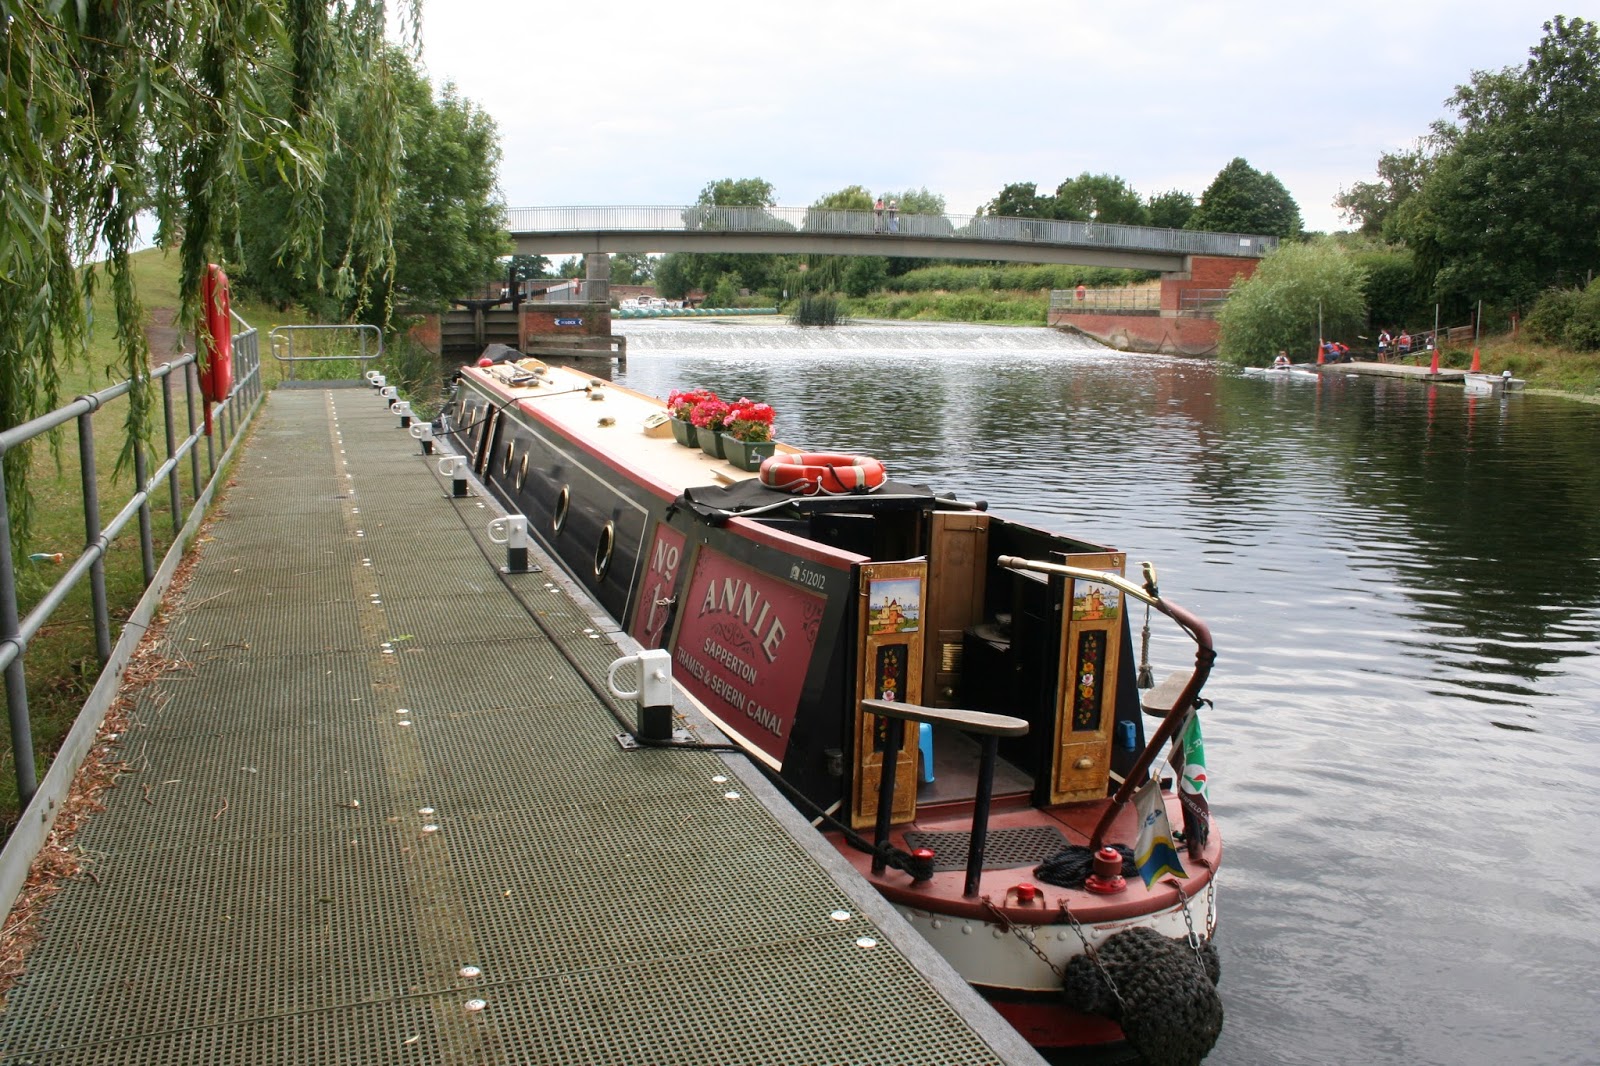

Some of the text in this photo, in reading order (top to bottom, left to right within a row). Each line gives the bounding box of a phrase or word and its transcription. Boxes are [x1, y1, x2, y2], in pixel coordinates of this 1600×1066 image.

[801, 569, 826, 590] 512012
[701, 577, 787, 663] ANNIE
[677, 645, 783, 738] THAMES & SEVERN CANAL
[703, 637, 757, 685] SAPPERTON
